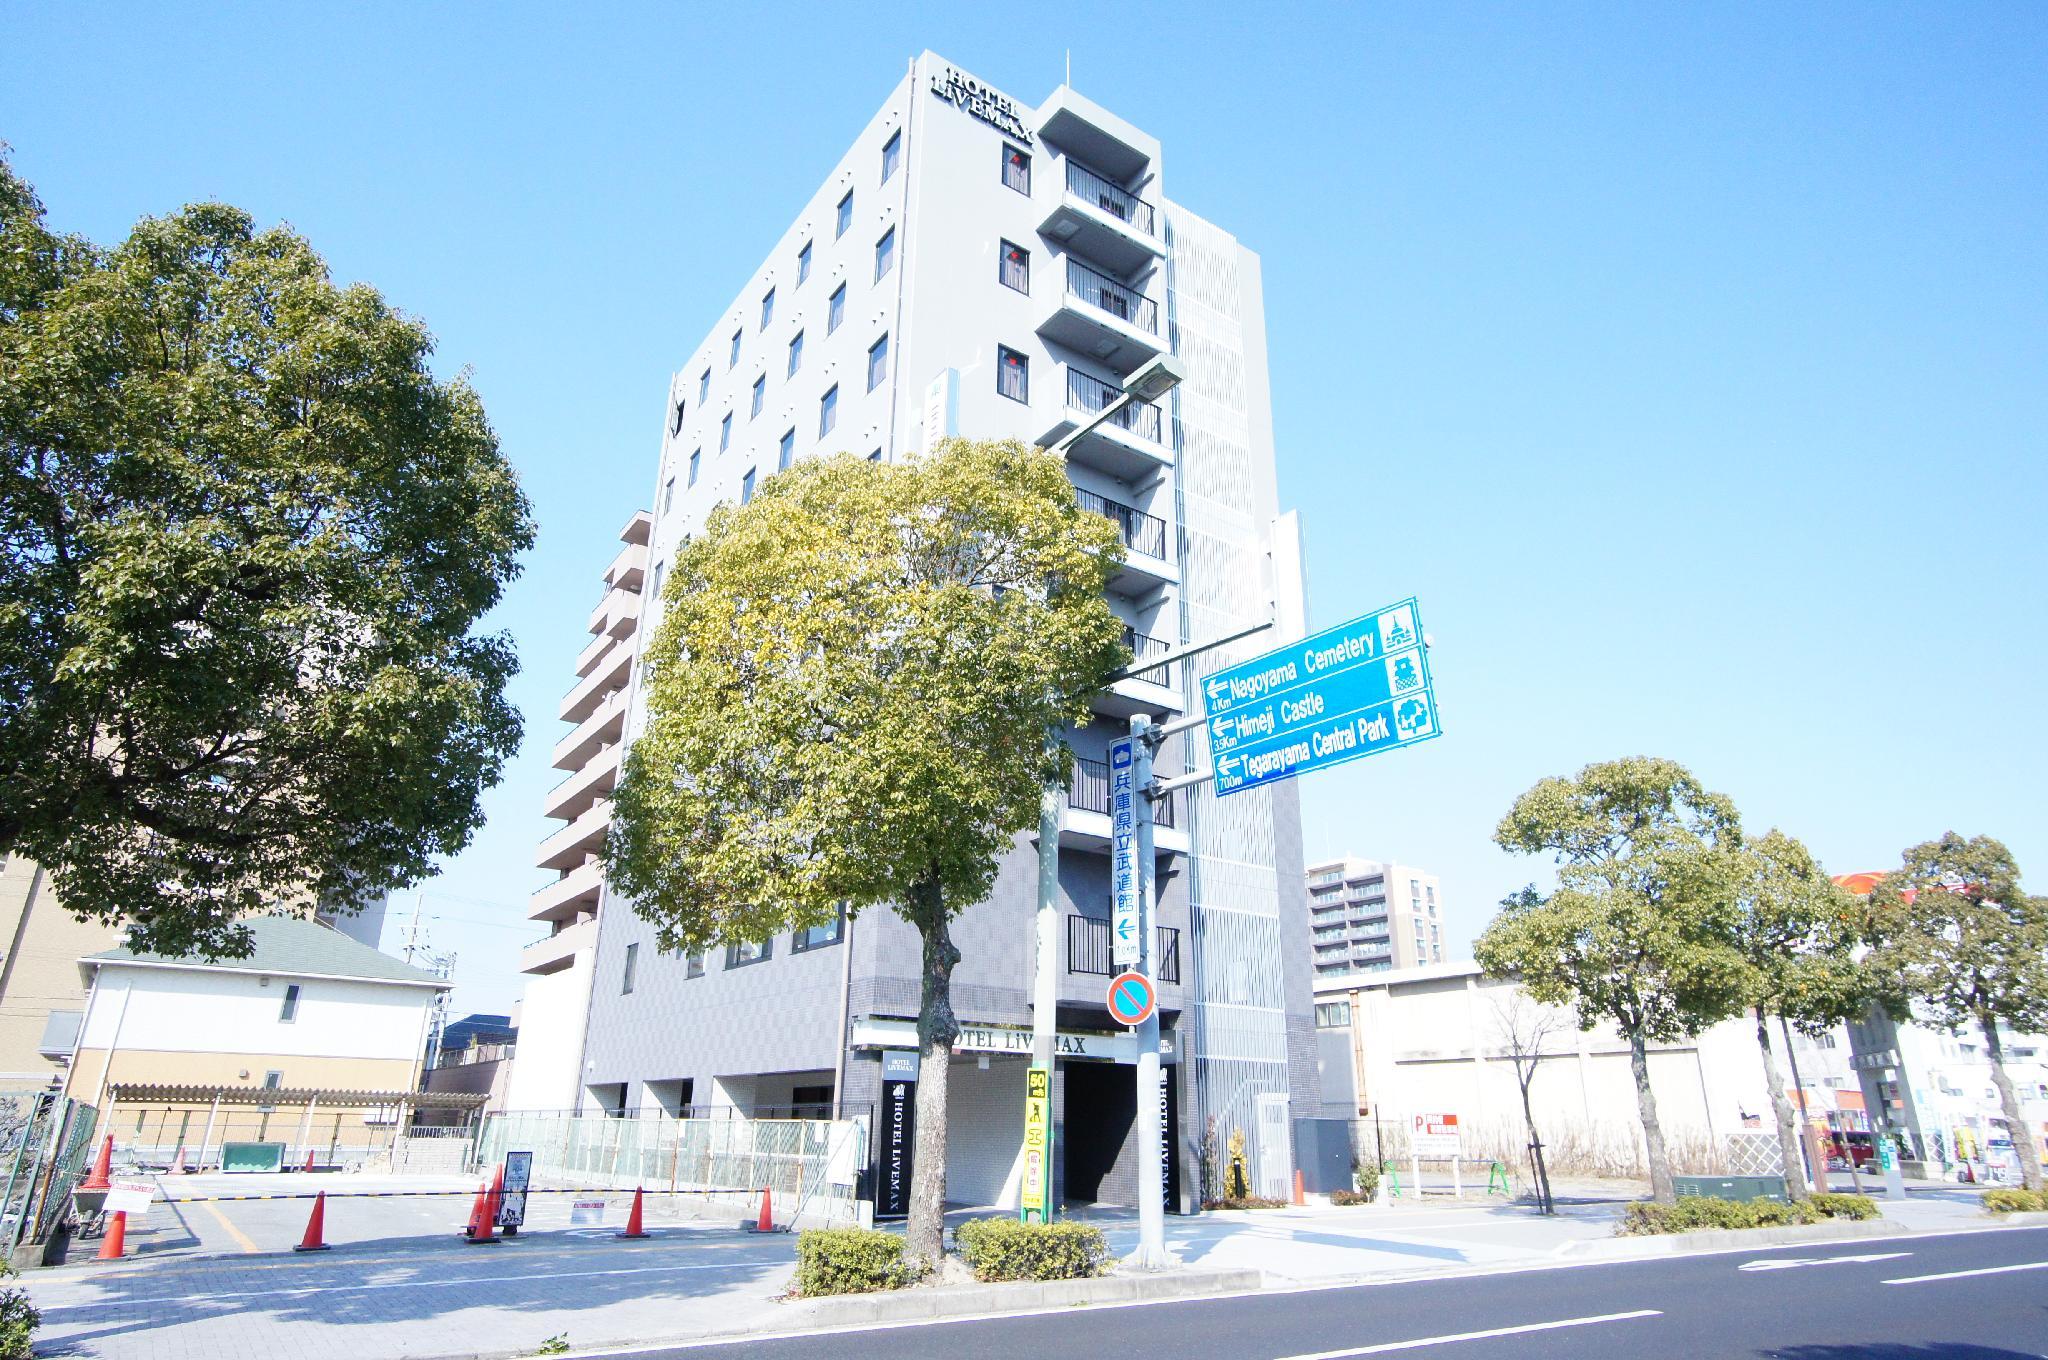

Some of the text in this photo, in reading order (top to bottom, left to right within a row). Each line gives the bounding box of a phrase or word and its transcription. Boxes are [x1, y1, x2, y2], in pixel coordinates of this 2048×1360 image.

[946, 67, 1018, 123] HOTEL
[1229, 632, 1375, 701] Nagoyama Cemetery
[1235, 691, 1325, 739] Himeji Castle
[1240, 712, 1391, 779] Tegarayama Central Park
[1218, 777, 1243, 791] 700m
[1114, 774, 1134, 913] 兵庫県立武道館
[1029, 1073, 1045, 1088] 50
[892, 1102, 904, 1146] HOTEL
[1415, 1115, 1424, 1132] P
